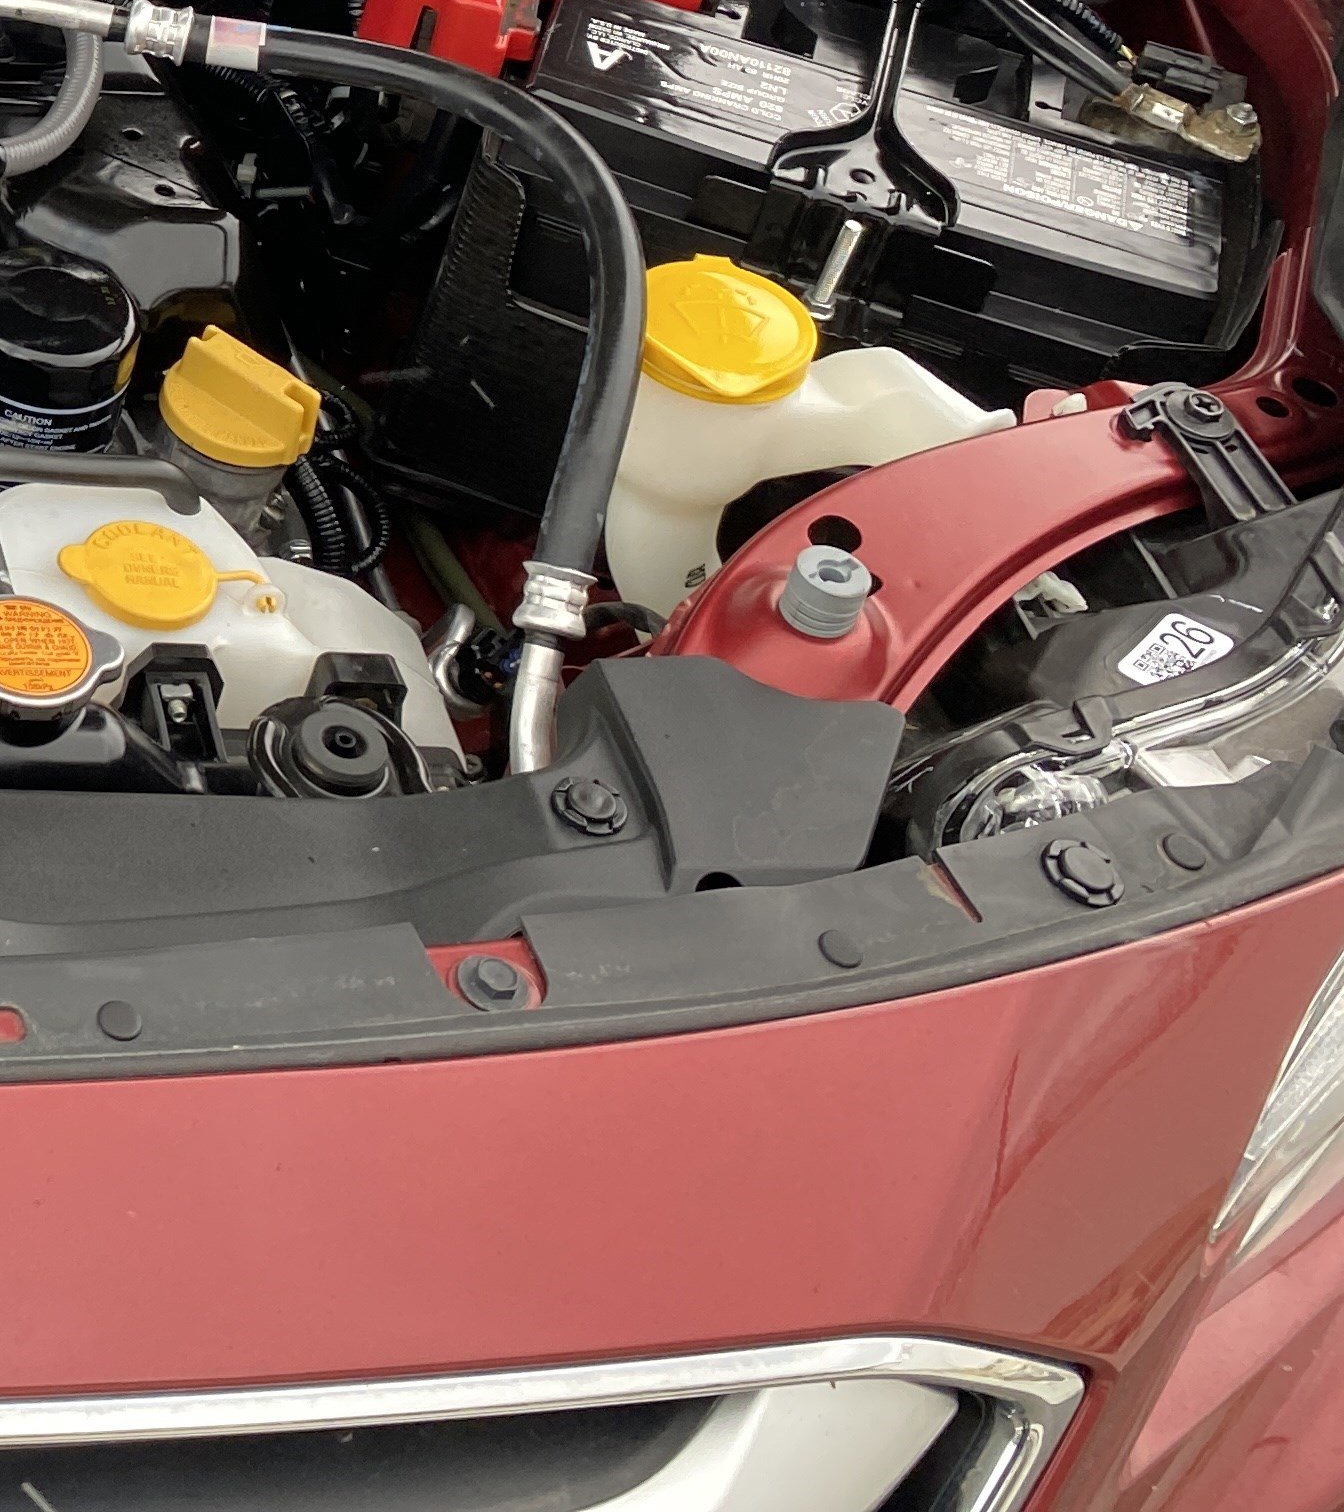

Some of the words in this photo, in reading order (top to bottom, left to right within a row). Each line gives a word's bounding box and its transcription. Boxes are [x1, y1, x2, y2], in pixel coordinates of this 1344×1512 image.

[658, 79, 691, 95] AMPS
[711, 85, 754, 104] AMPS
[745, 86, 786, 103] GROUP
[758, 80, 788, 95] LN2
[692, 91, 749, 111] CRANKING
[749, 106, 782, 121] COLD
[4, 409, 53, 426] CAUTION
[125, 576, 180, 588] MANUAL
[1159, 620, 1215, 659] 26
